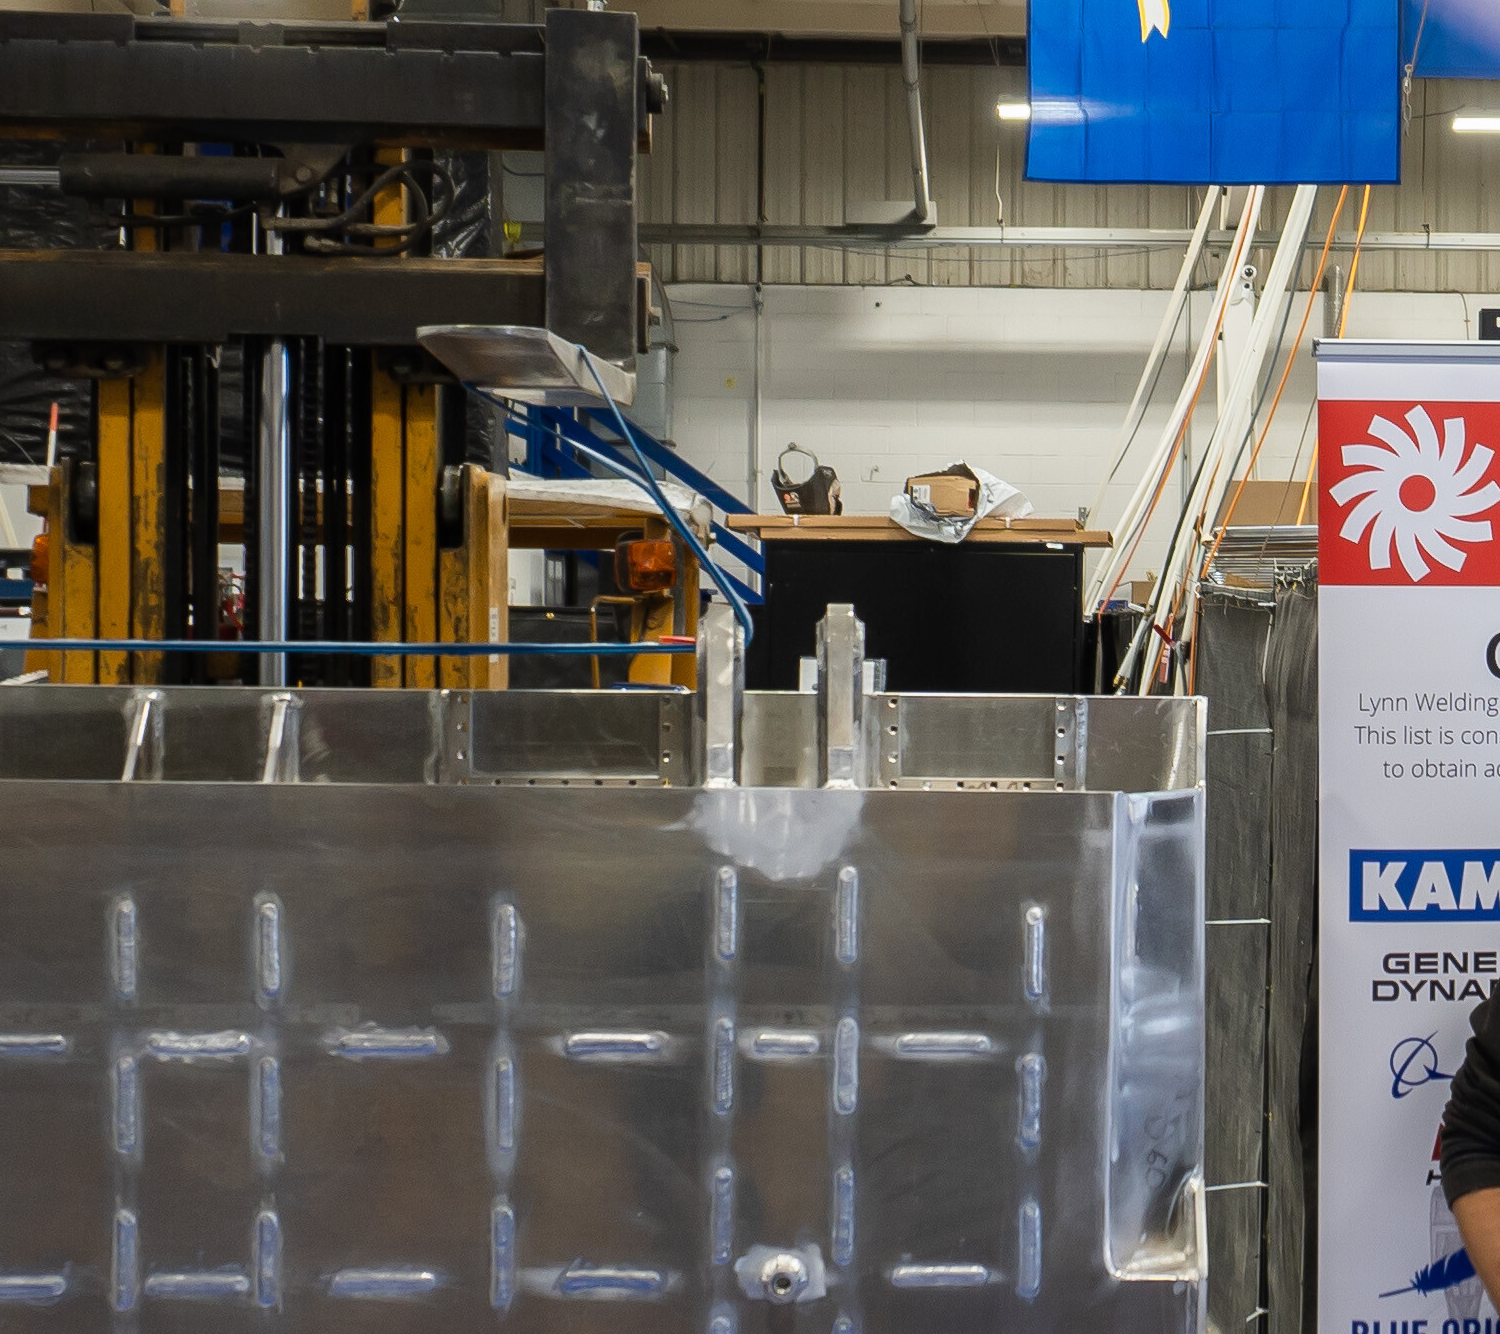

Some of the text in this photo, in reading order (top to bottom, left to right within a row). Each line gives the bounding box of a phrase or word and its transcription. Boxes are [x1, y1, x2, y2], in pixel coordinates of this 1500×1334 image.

[1359, 693, 1408, 717] Lynn
[1415, 692, 1499, 717] Welding
[1354, 725, 1397, 745] This
[1403, 725, 1432, 745] list
[1439, 726, 1454, 745] is
[1383, 761, 1405, 778] to
[1411, 758, 1477, 779] obtain
[1372, 979, 1499, 1002] DYNA
